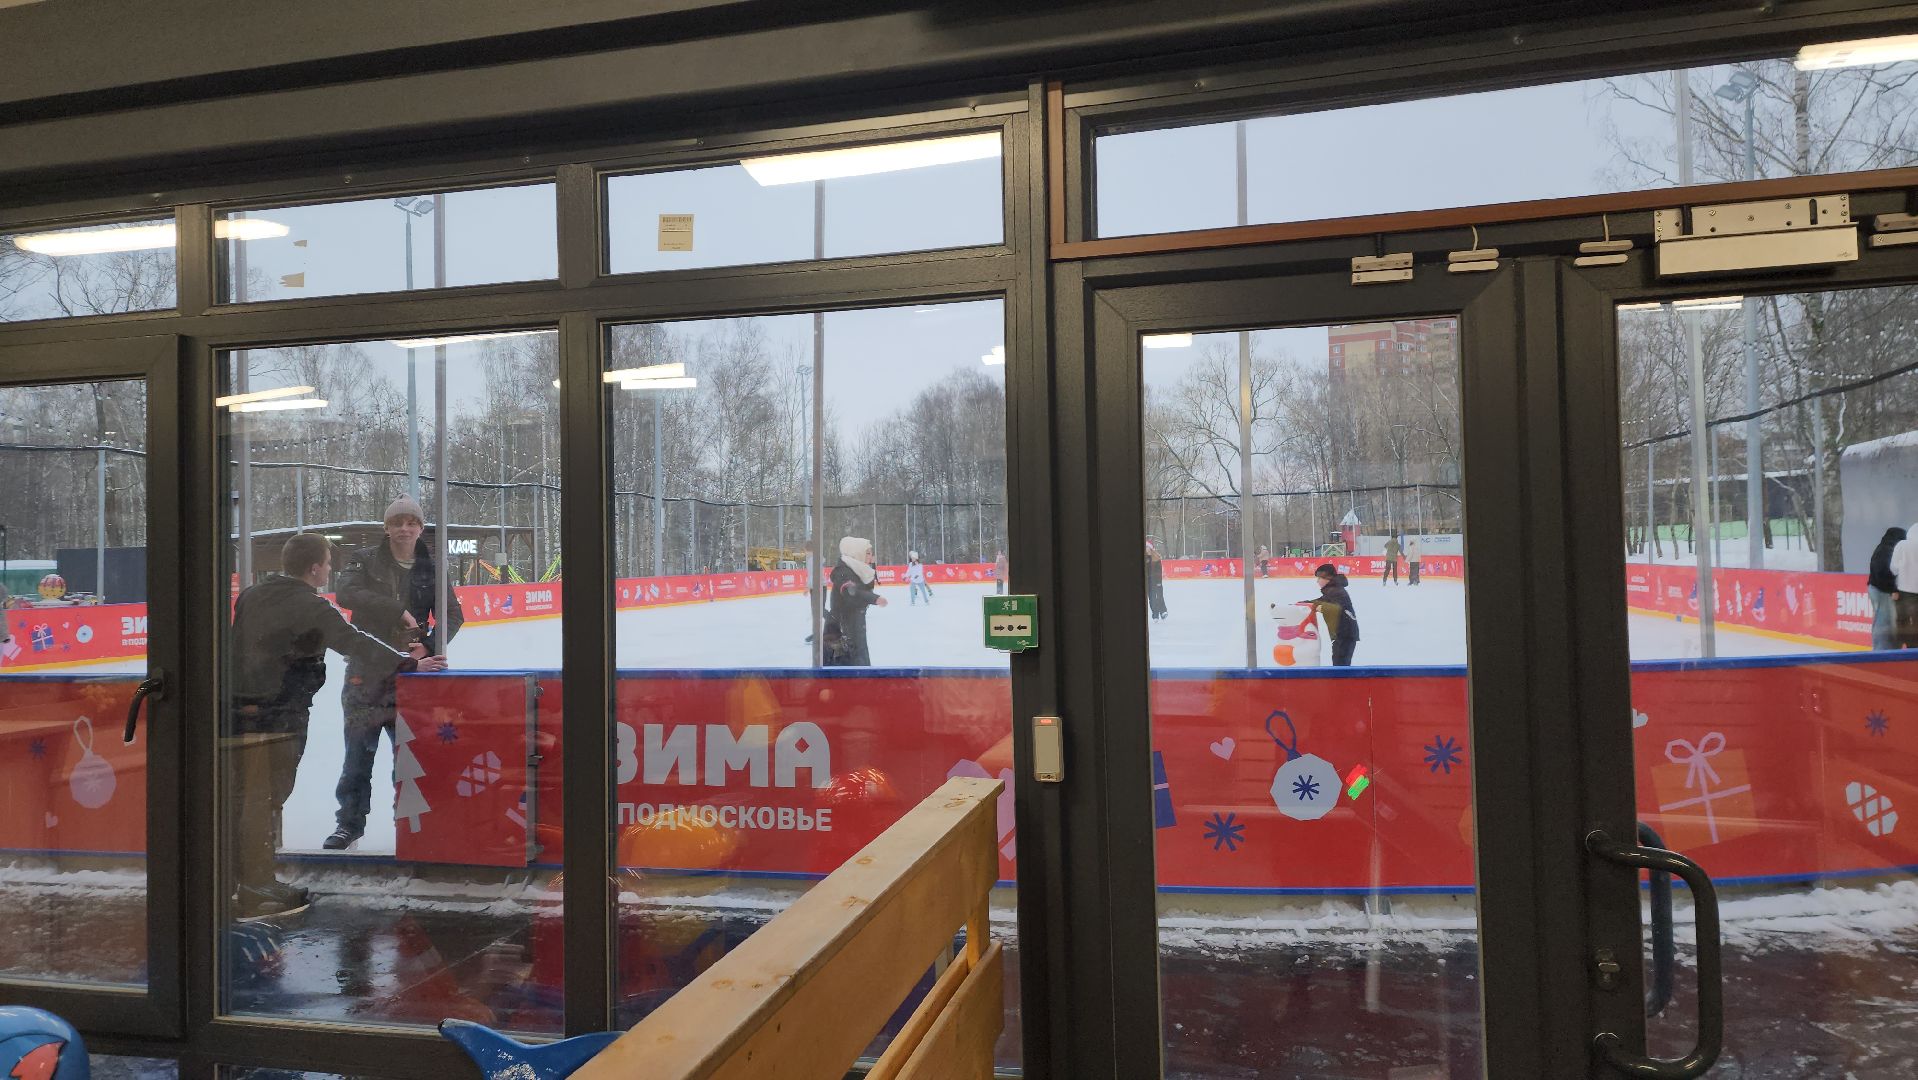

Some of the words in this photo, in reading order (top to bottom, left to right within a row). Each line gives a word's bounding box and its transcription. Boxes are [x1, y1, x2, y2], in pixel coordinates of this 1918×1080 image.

[448, 539, 477, 554] КАФЕ
[525, 590, 552, 603] ЗИМА
[1836, 590, 1873, 617] ЗИМ
[121, 615, 147, 635] ЗИ
[617, 802, 832, 831] ПОДМОСКОВЬЕ
